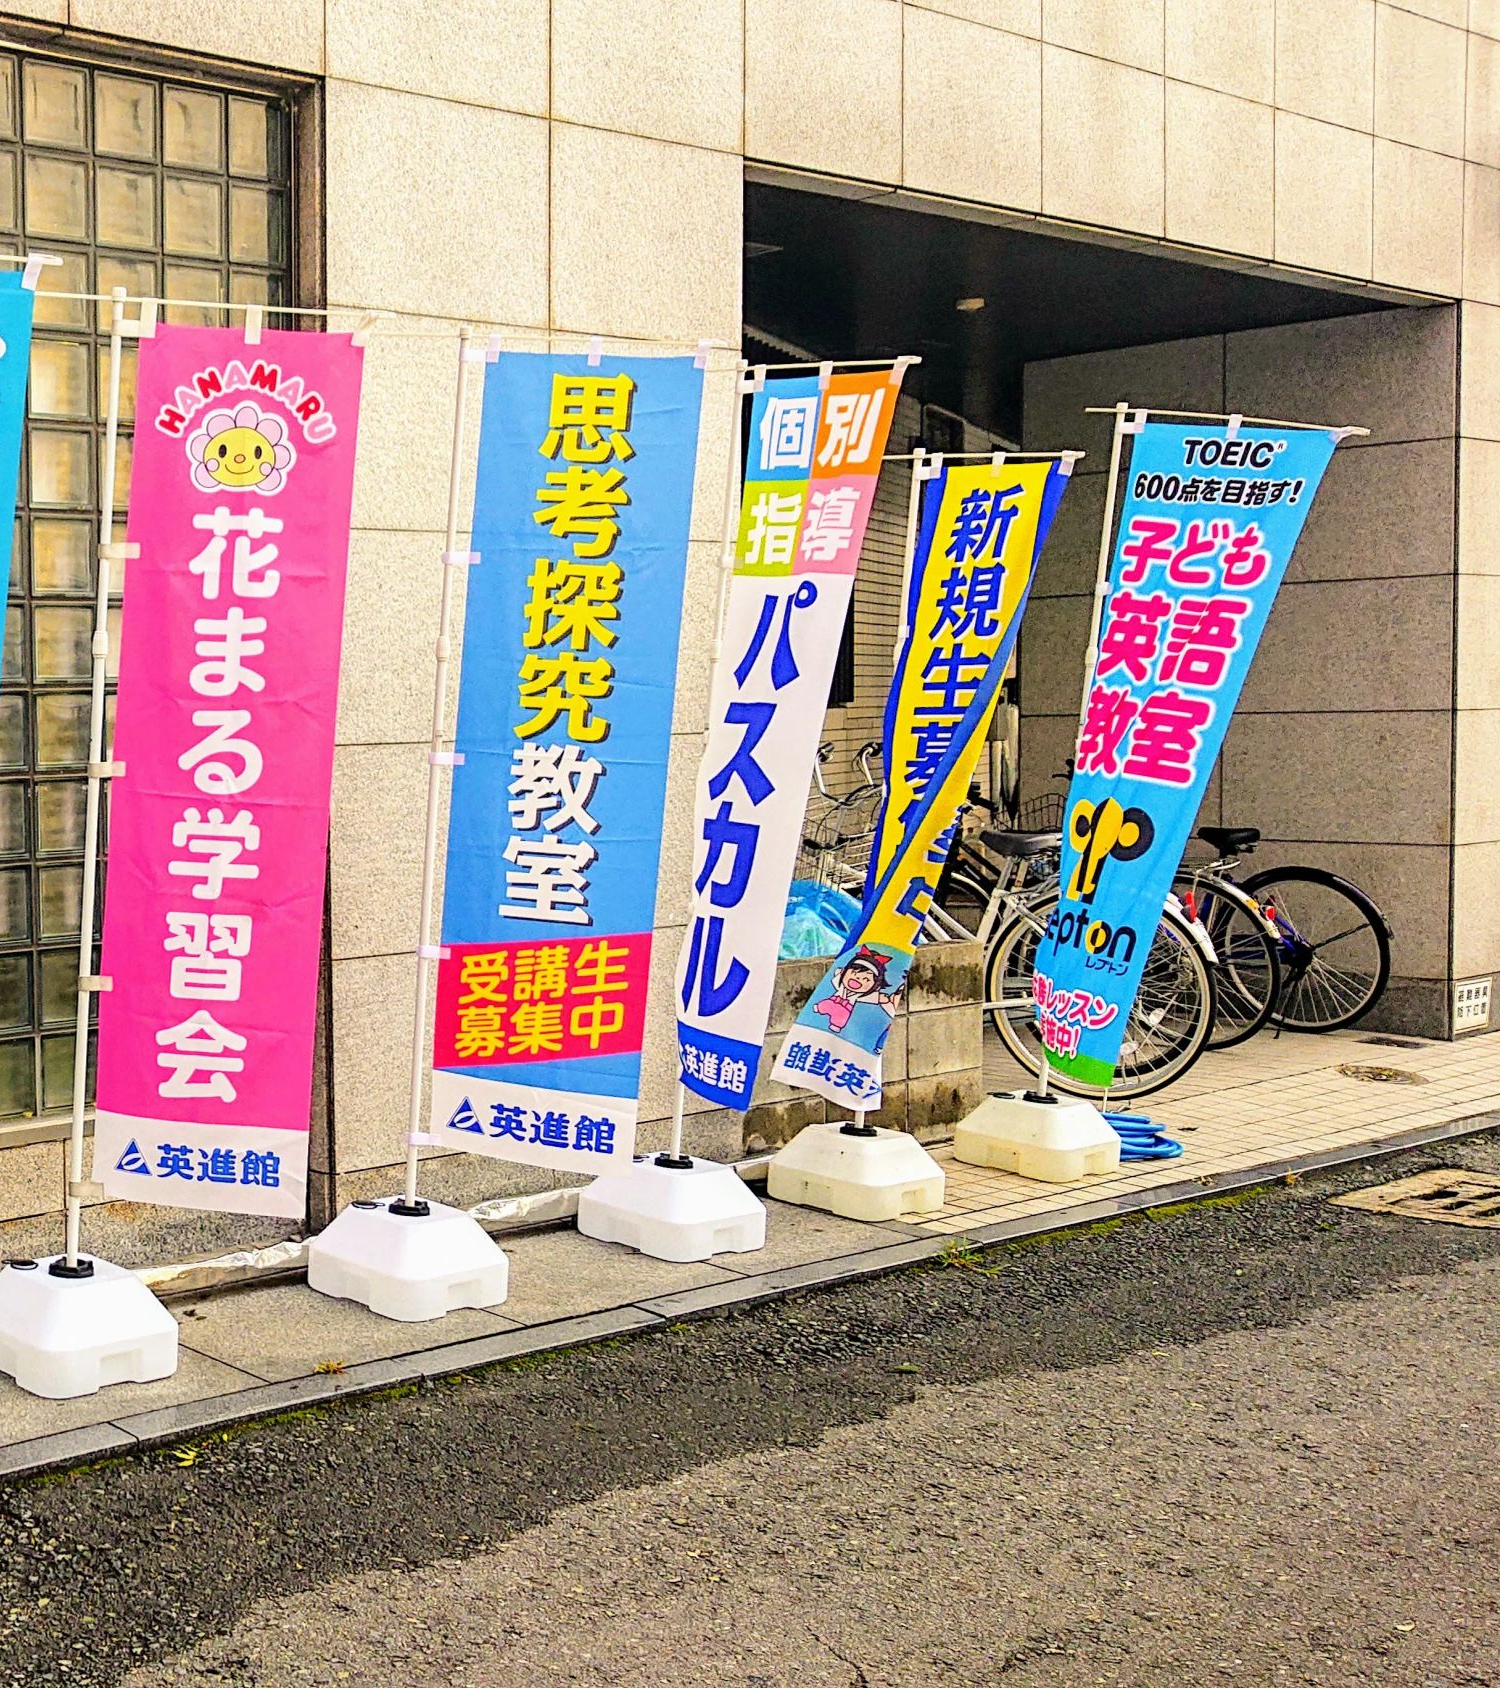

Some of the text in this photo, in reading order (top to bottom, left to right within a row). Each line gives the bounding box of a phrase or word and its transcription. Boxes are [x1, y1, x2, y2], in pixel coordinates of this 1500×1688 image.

[158, 361, 336, 442] HANAMARU
[759, 387, 887, 471] 個別
[744, 487, 862, 566] 指導
[1120, 518, 1267, 587] 子ども
[498, 372, 636, 926] 思考探究教室
[1096, 590, 1248, 687] 英語
[1076, 684, 1211, 785] 教室
[155, 505, 284, 1103] 花まる学習会
[682, 580, 818, 1018] パスカル
[1045, 907, 1137, 963] epton
[1085, 955, 1129, 977] レプトン
[457, 941, 630, 1005] 受講生
[1033, 972, 1117, 1026] レッスン
[454, 996, 625, 1058] 募集中
[682, 1043, 748, 1094] 英進館
[489, 1104, 616, 1155] 英進館
[157, 1143, 281, 1188] 英進館
